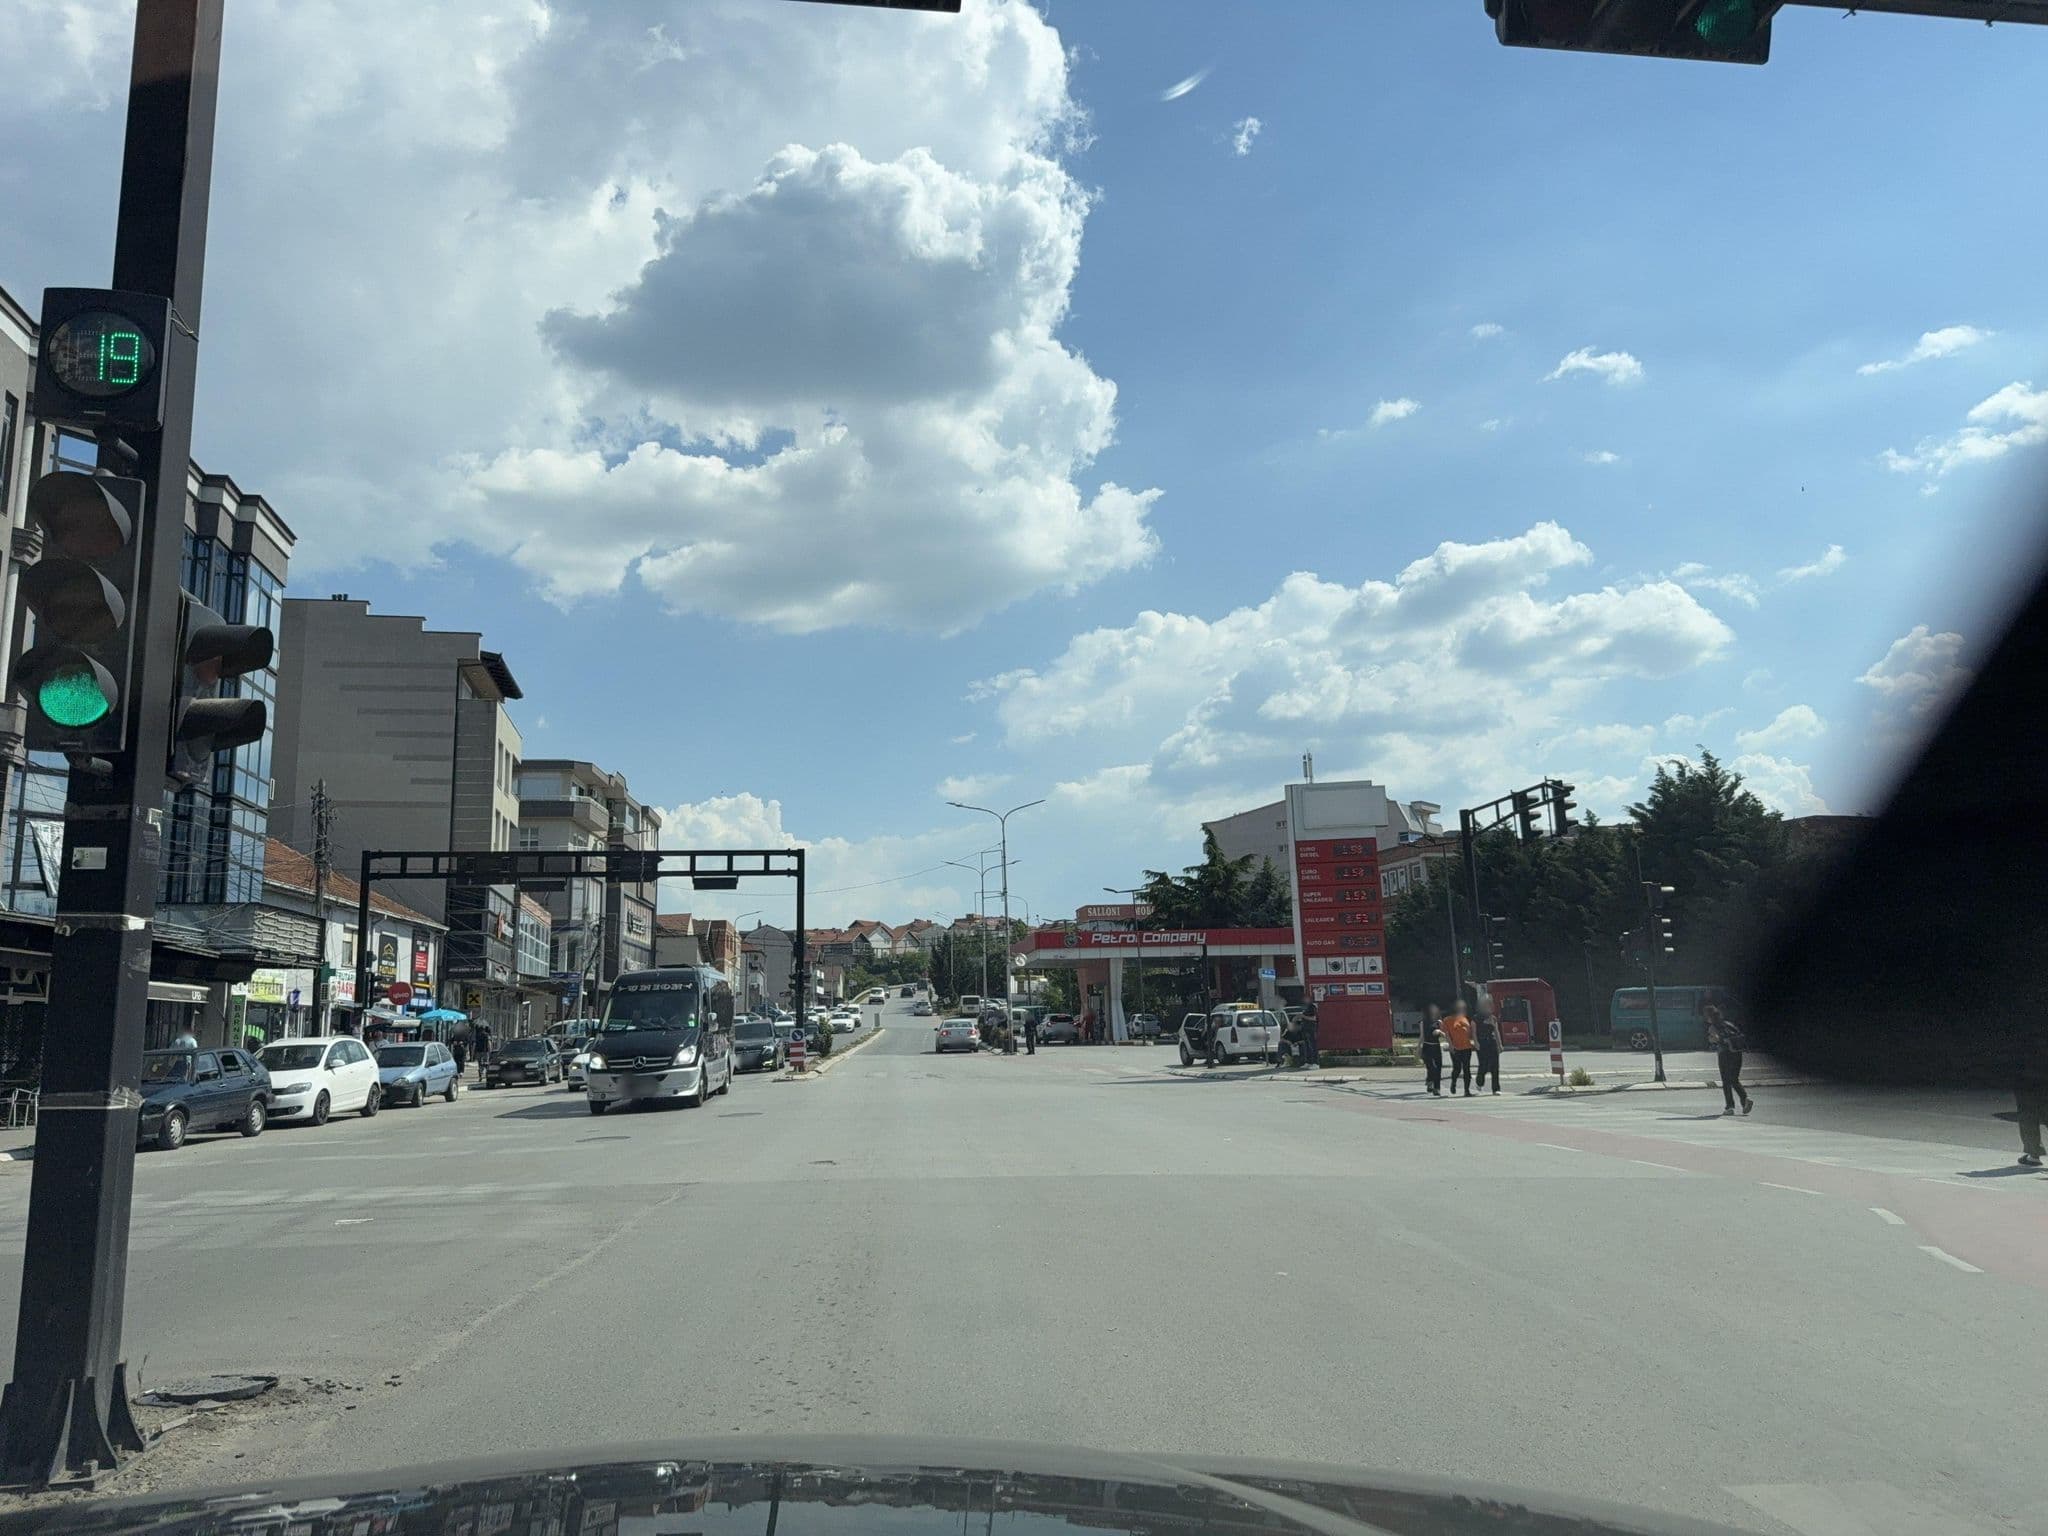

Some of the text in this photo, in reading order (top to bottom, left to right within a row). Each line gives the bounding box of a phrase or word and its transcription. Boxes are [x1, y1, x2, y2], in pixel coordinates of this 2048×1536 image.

[98, 331, 140, 385] 19
[1087, 906, 1121, 917] SALLONI
[1142, 931, 1207, 945] Company
